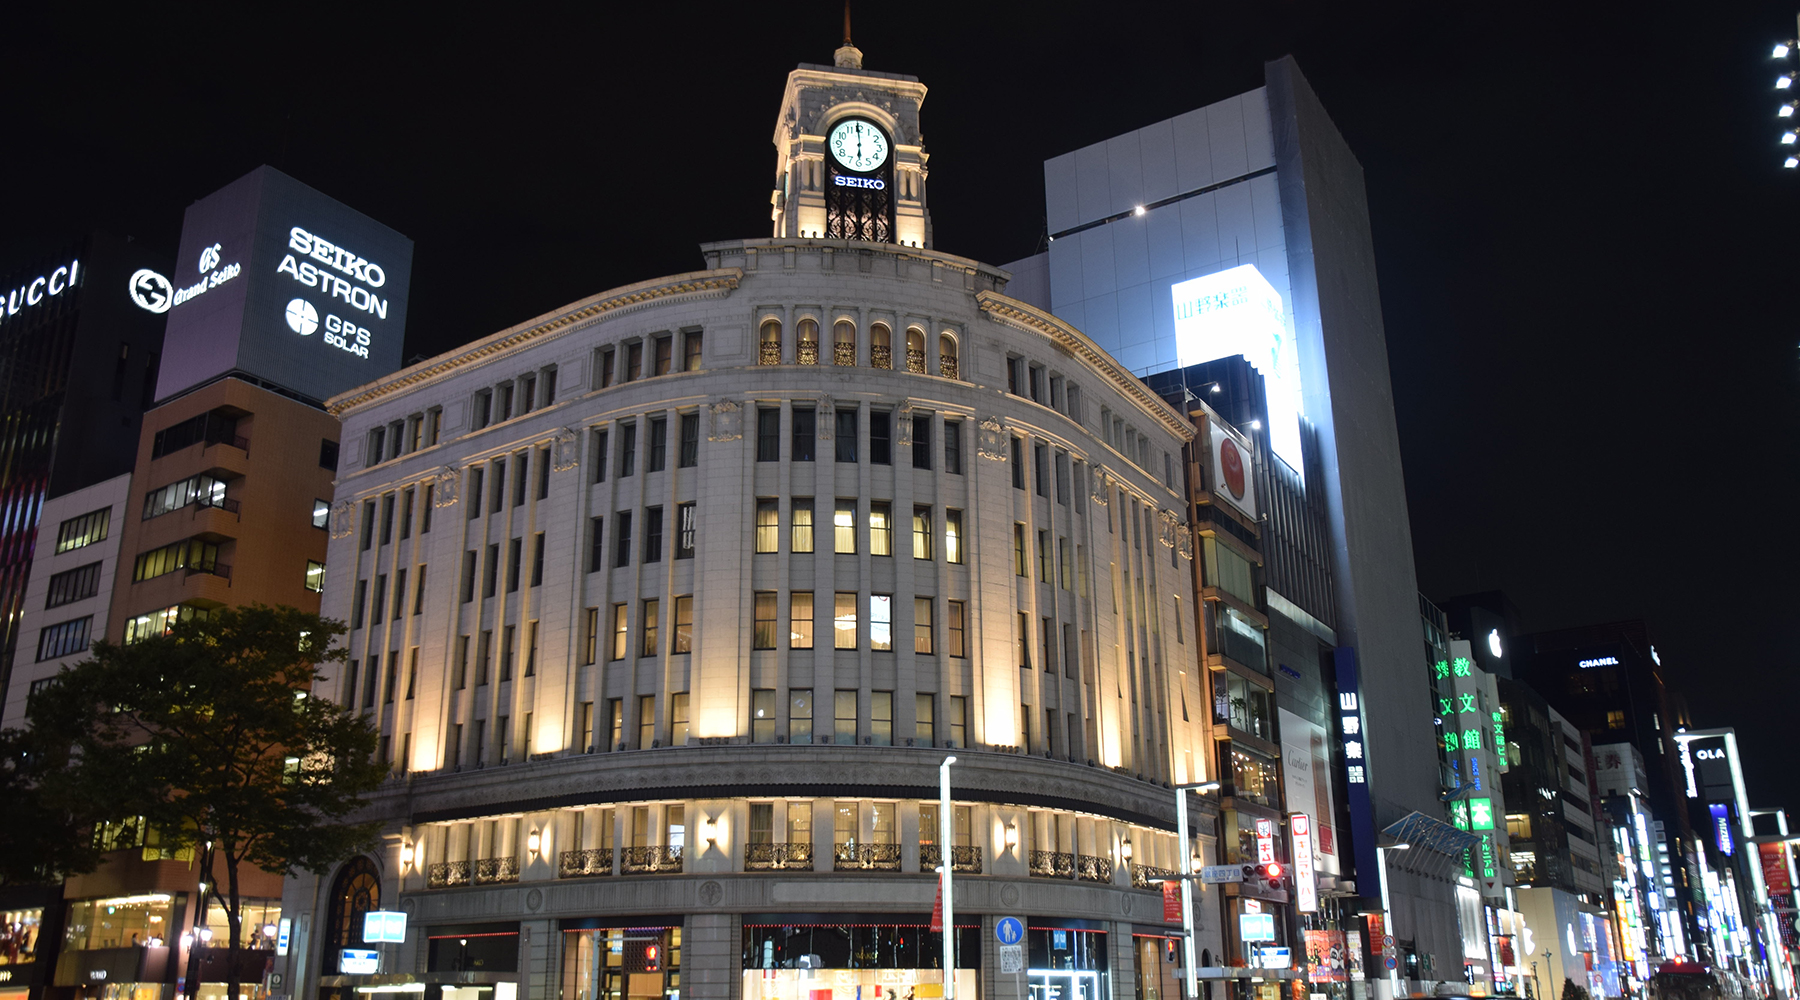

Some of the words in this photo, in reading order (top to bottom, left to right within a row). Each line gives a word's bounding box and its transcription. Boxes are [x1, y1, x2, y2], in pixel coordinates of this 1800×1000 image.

[835, 140, 843, 149] 9
[873, 135, 880, 143] 2
[876, 144, 883, 153] 3
[838, 149, 846, 157] 8
[847, 155, 854, 164] 7
[855, 159, 863, 167] 6
[865, 157, 872, 166] 5
[872, 152, 879, 161] 4
[835, 176, 885, 191] SEIKO
[198, 242, 222, 274] GS
[288, 226, 386, 288] SEIKO
[173, 275, 209, 306] Grand
[208, 262, 241, 288] Seiko
[276, 254, 388, 320] ASTRON
[1177, 285, 1248, 320] 山野楽器
[325, 313, 372, 346] GPS
[323, 331, 369, 359] SOLAR
[1578, 656, 1619, 669] CHANEL
[1453, 657, 1481, 750] 教文館
[1339, 692, 1365, 784] 山野楽器
[1287, 749, 1309, 772] Cartier
[1471, 802, 1491, 826] 本
